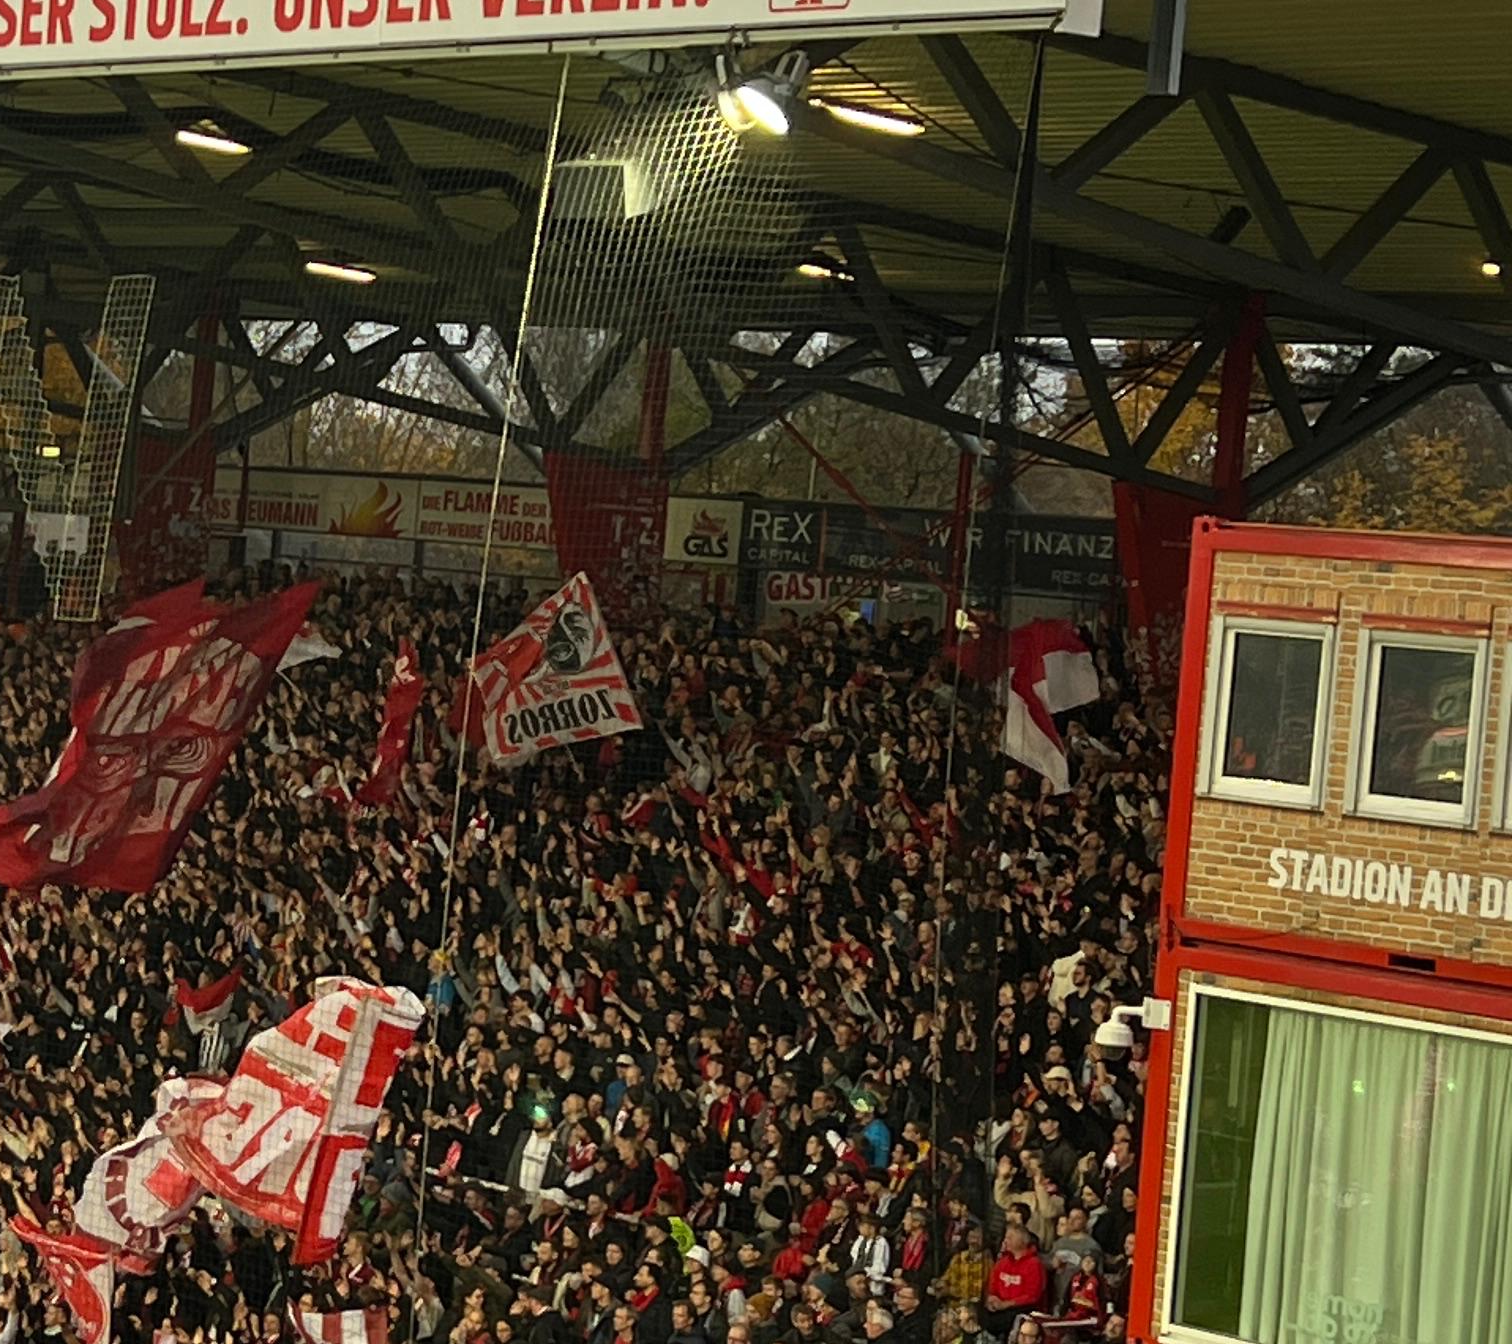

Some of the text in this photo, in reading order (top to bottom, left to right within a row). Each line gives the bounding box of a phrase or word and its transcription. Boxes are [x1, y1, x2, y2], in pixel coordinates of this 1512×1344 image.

[683, 533, 728, 557] GAS
[1267, 848, 1413, 908] STADION
[1420, 868, 1471, 916] AN
